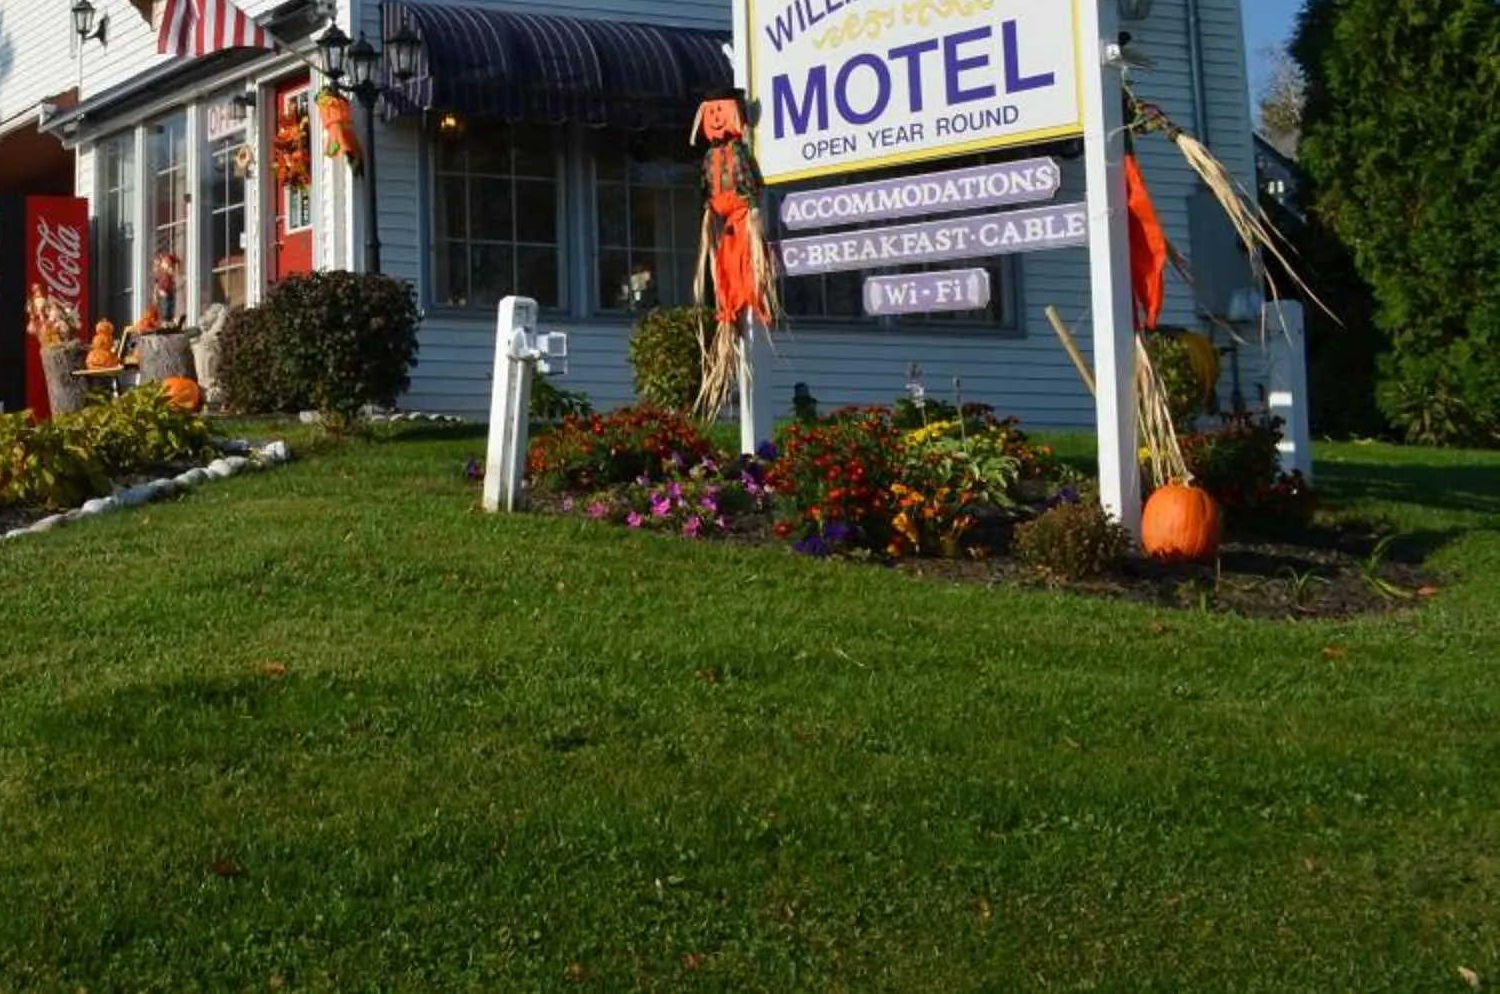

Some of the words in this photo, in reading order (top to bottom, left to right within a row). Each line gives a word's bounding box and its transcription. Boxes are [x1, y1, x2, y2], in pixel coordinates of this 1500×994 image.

[772, 19, 1055, 139] MOTEL
[801, 134, 857, 160] OPEN
[867, 123, 924, 150] YEAR
[935, 105, 1020, 137] ROUND
[785, 165, 1054, 223] ACCOMMODATIONS
[884, 279, 962, 305] Wi-Fi
